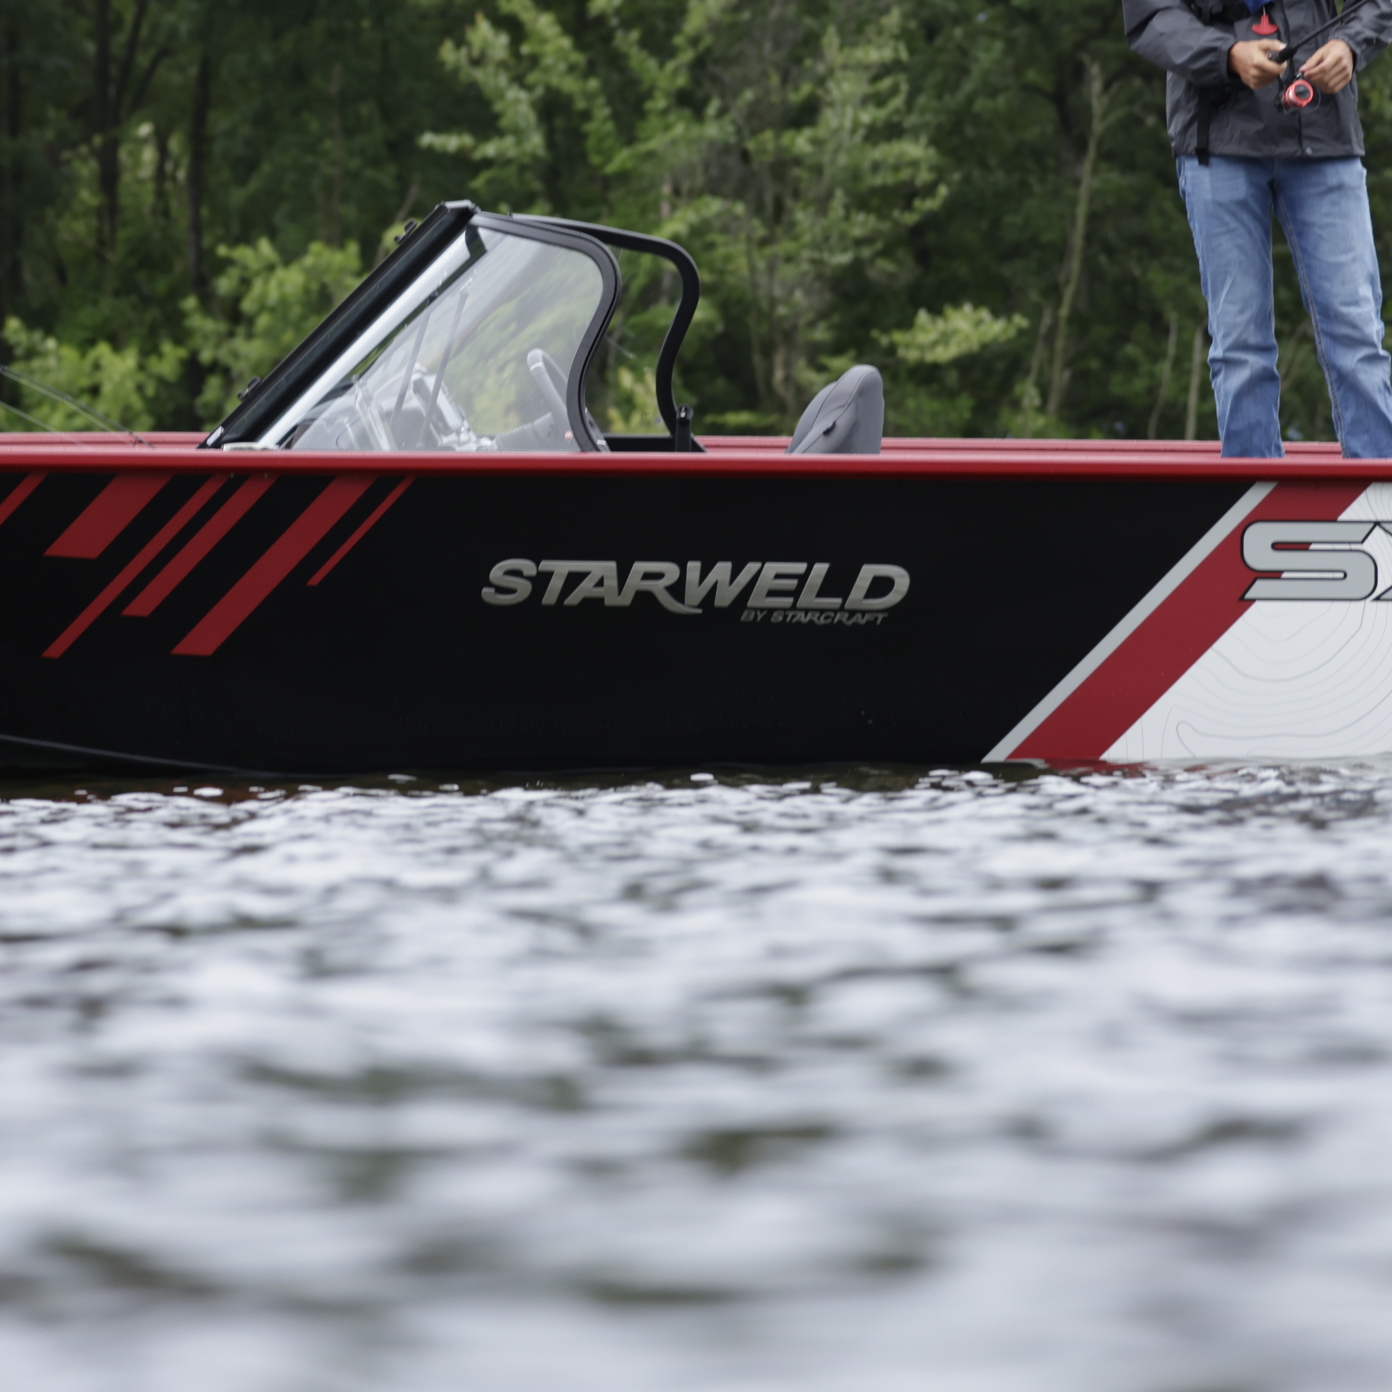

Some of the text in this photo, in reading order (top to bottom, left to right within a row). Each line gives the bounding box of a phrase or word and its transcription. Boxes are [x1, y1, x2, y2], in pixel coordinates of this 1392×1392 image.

[481, 558, 910, 614] STARWELD
[740, 609, 888, 626] BY STARCRAFT
